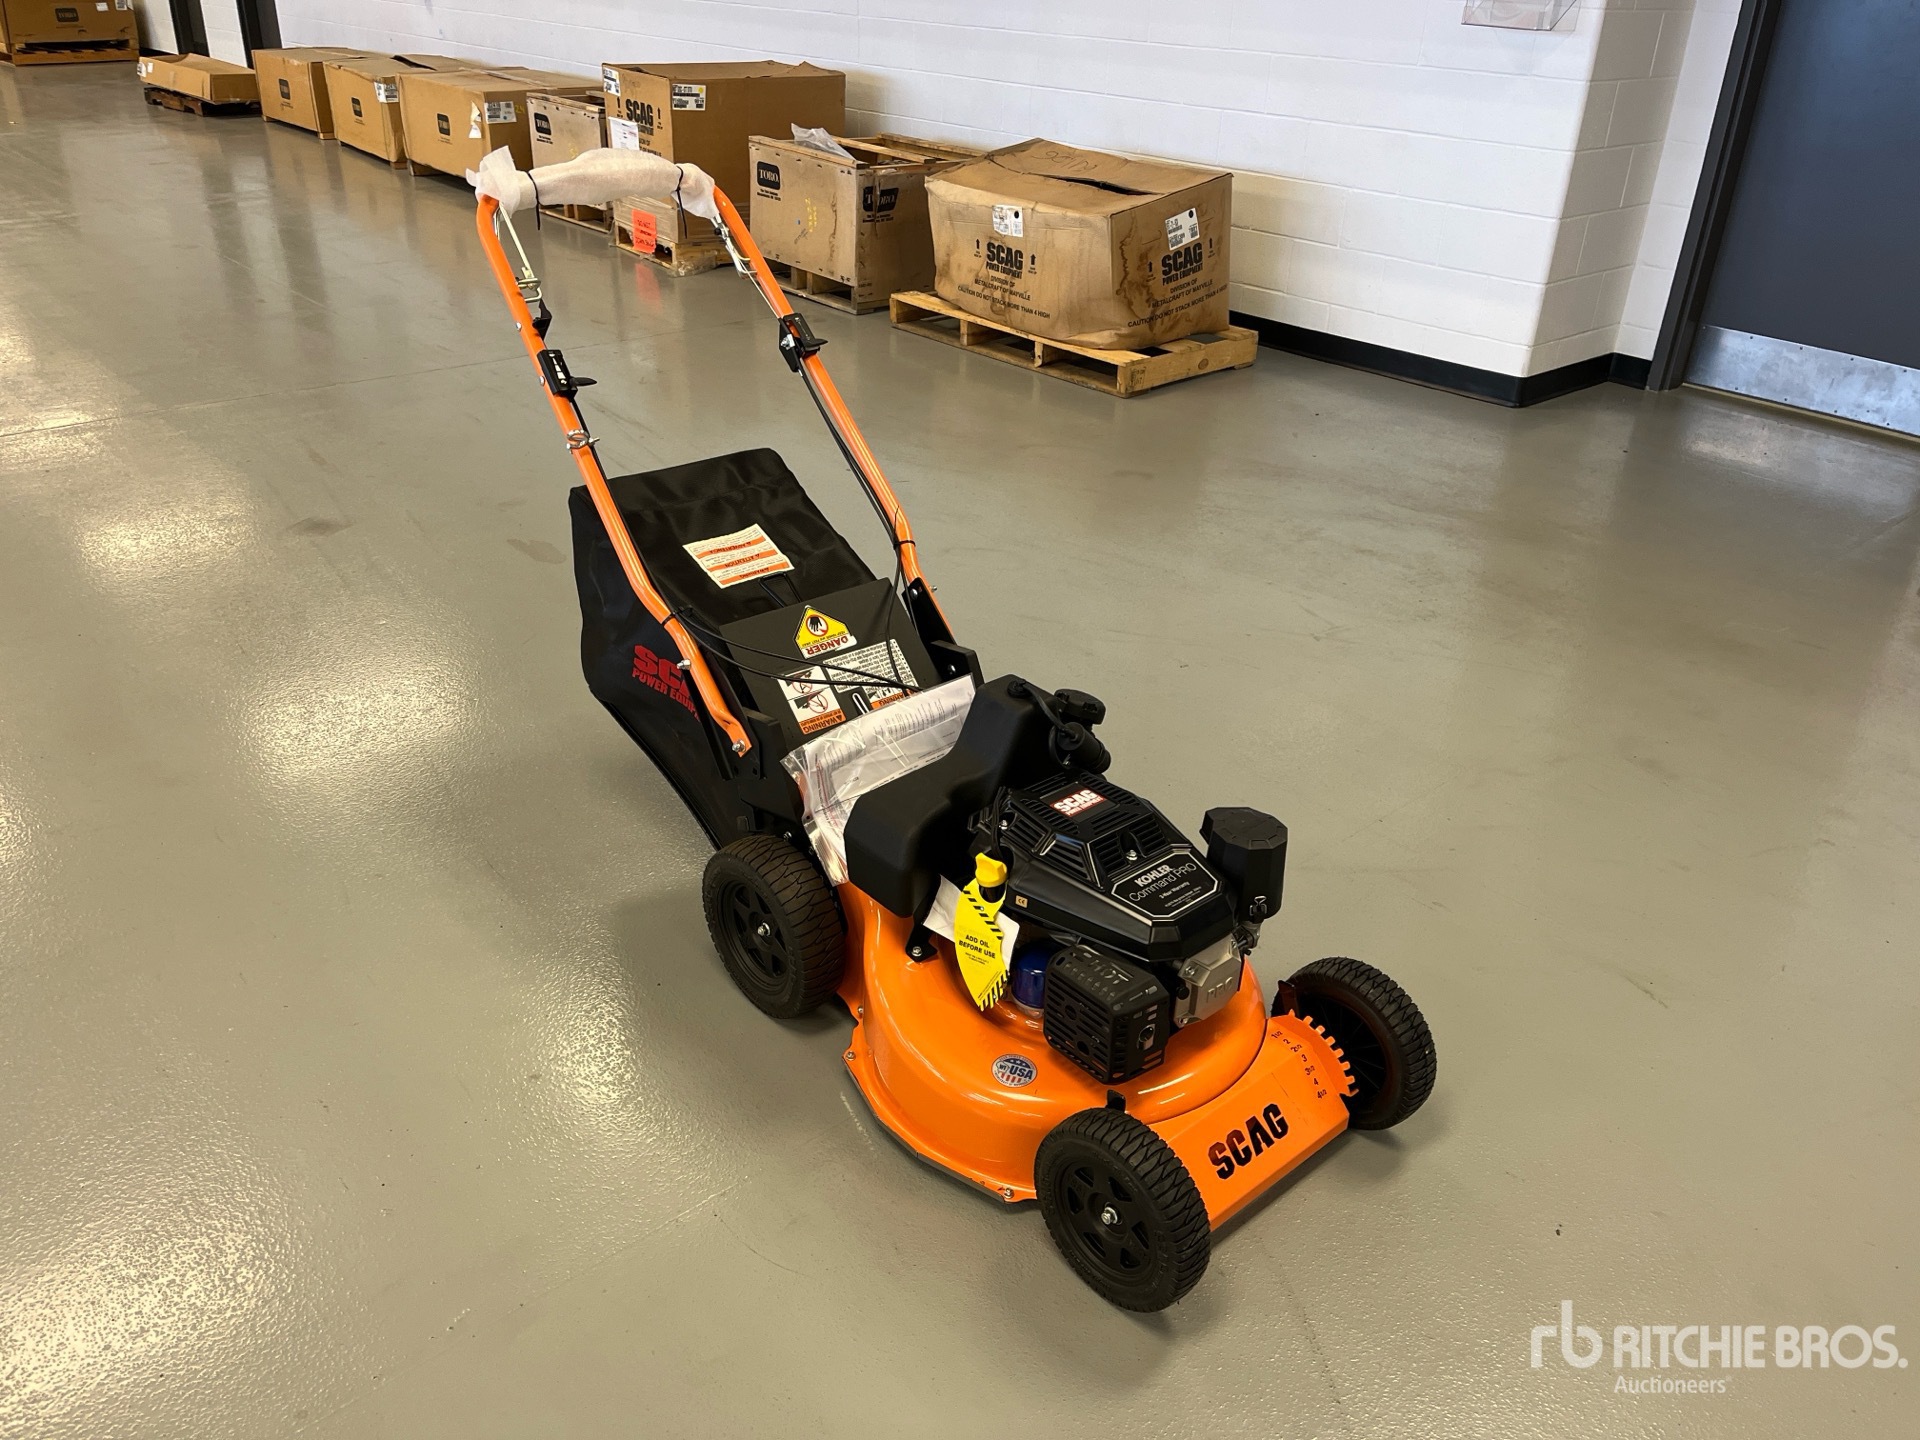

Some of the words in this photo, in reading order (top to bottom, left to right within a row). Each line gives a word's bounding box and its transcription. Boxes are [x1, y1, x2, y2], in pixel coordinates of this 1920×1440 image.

[625, 98, 654, 127] SCAG
[986, 241, 1023, 270] SCAG
[1161, 242, 1203, 276] SCAG
[986, 261, 1000, 273] POWER
[1000, 265, 1022, 279] EQUIPMENT
[990, 275, 1009, 286] DIVISION
[1162, 273, 1178, 286] POWER
[1179, 263, 1203, 279] EQUIPMENT
[974, 278, 1002, 292] METALCRAFT
[1009, 288, 1031, 301] MAYVILLE
[1151, 293, 1185, 308] METALCRAFT
[1185, 289, 1193, 297] OF
[1192, 279, 1213, 293] MAYVILLE
[1170, 281, 1191, 294] DIVISION
[1191, 278, 1198, 286] OF
[957, 285, 975, 296] CAUTION
[975, 291, 982, 299] DO
[982, 293, 992, 301] NOT
[992, 296, 1007, 306] STACK
[1007, 301, 1020, 311] MORE
[1020, 305, 1033, 315] THAN
[1038, 310, 1050, 319] HIGH
[1128, 316, 1153, 328] CAUTION
[1153, 312, 1163, 321] DO
[1163, 308, 1174, 317] NOT
[1175, 302, 1190, 313] STACK
[1191, 296, 1205, 307] MORE
[1205, 291, 1216, 300] THAN
[725, 556, 754, 568] ATTENTION
[805, 636, 849, 655] DANGER
[632, 668, 668, 695] POWER
[879, 692, 905, 706] ARNING
[803, 716, 837, 733] WARNING
[1053, 789, 1098, 812] SCAG
[1128, 873, 1177, 901] Command
[1173, 862, 1197, 878] PRO
[1134, 864, 1172, 887] KOHLER
[958, 940, 982, 953] BEFORE
[983, 949, 996, 959] USE
[965, 934, 978, 944] ADD
[979, 939, 990, 948] OIL
[1301, 1054, 1308, 1062] 3
[1009, 1065, 1033, 1080] USA
[1208, 1103, 1289, 1180] SCAG
